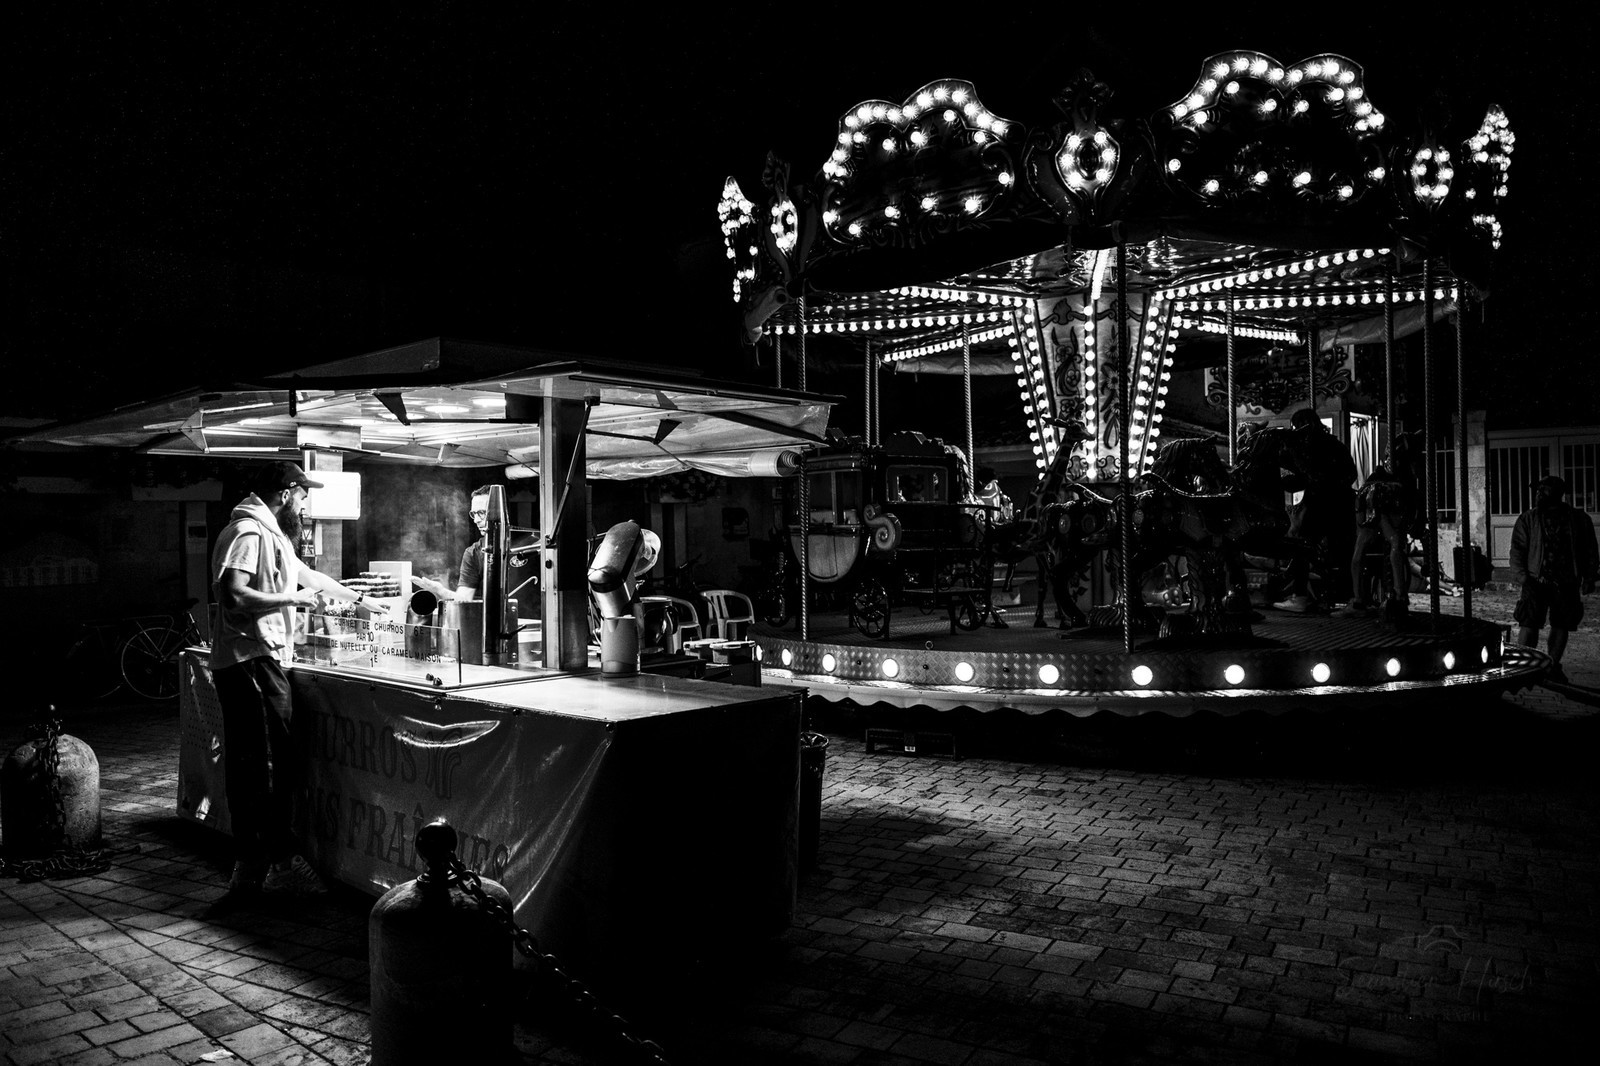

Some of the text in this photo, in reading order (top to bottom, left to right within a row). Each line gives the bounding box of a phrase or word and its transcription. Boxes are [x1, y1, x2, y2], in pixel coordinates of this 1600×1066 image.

[362, 621, 370, 630] DE
[374, 622, 404, 634] CHURROS
[356, 631, 375, 642] PAR 10
[330, 639, 338, 648] DE
[340, 641, 366, 652] NUTELLA
[369, 644, 378, 653] OU
[382, 646, 413, 659] CARAMEL
[414, 651, 441, 663] MAISON
